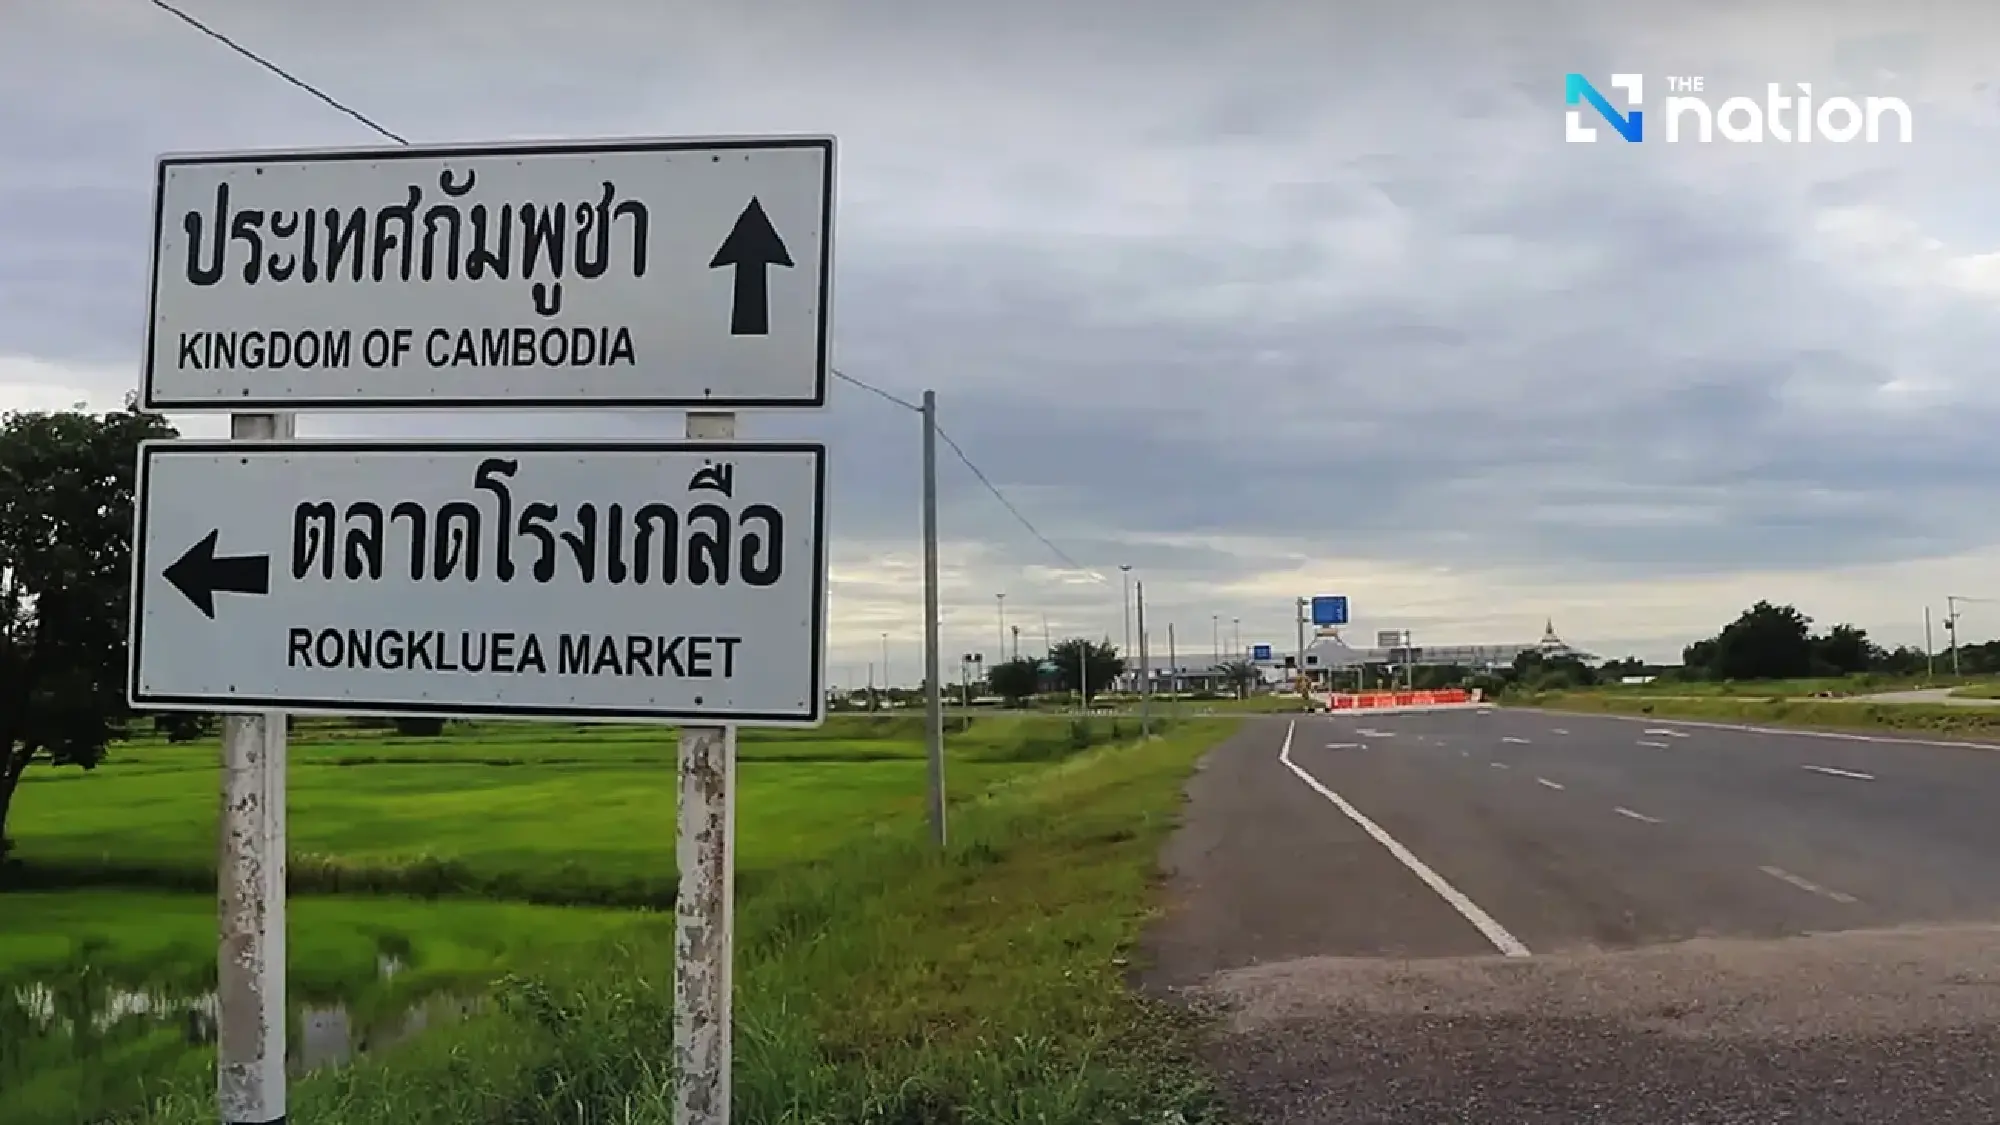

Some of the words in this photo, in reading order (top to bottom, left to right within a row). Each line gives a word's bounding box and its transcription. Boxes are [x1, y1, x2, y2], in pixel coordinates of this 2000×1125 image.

[184, 168, 649, 315] ประเทศกัมพูชา
[179, 330, 352, 370] KINGDOM
[362, 329, 413, 369] OF
[425, 326, 636, 369] CAMBODIA
[291, 459, 784, 587] ตลาดโรงเกลือ
[288, 627, 547, 675] RONGKLUEA
[557, 633, 743, 678] MARKET
